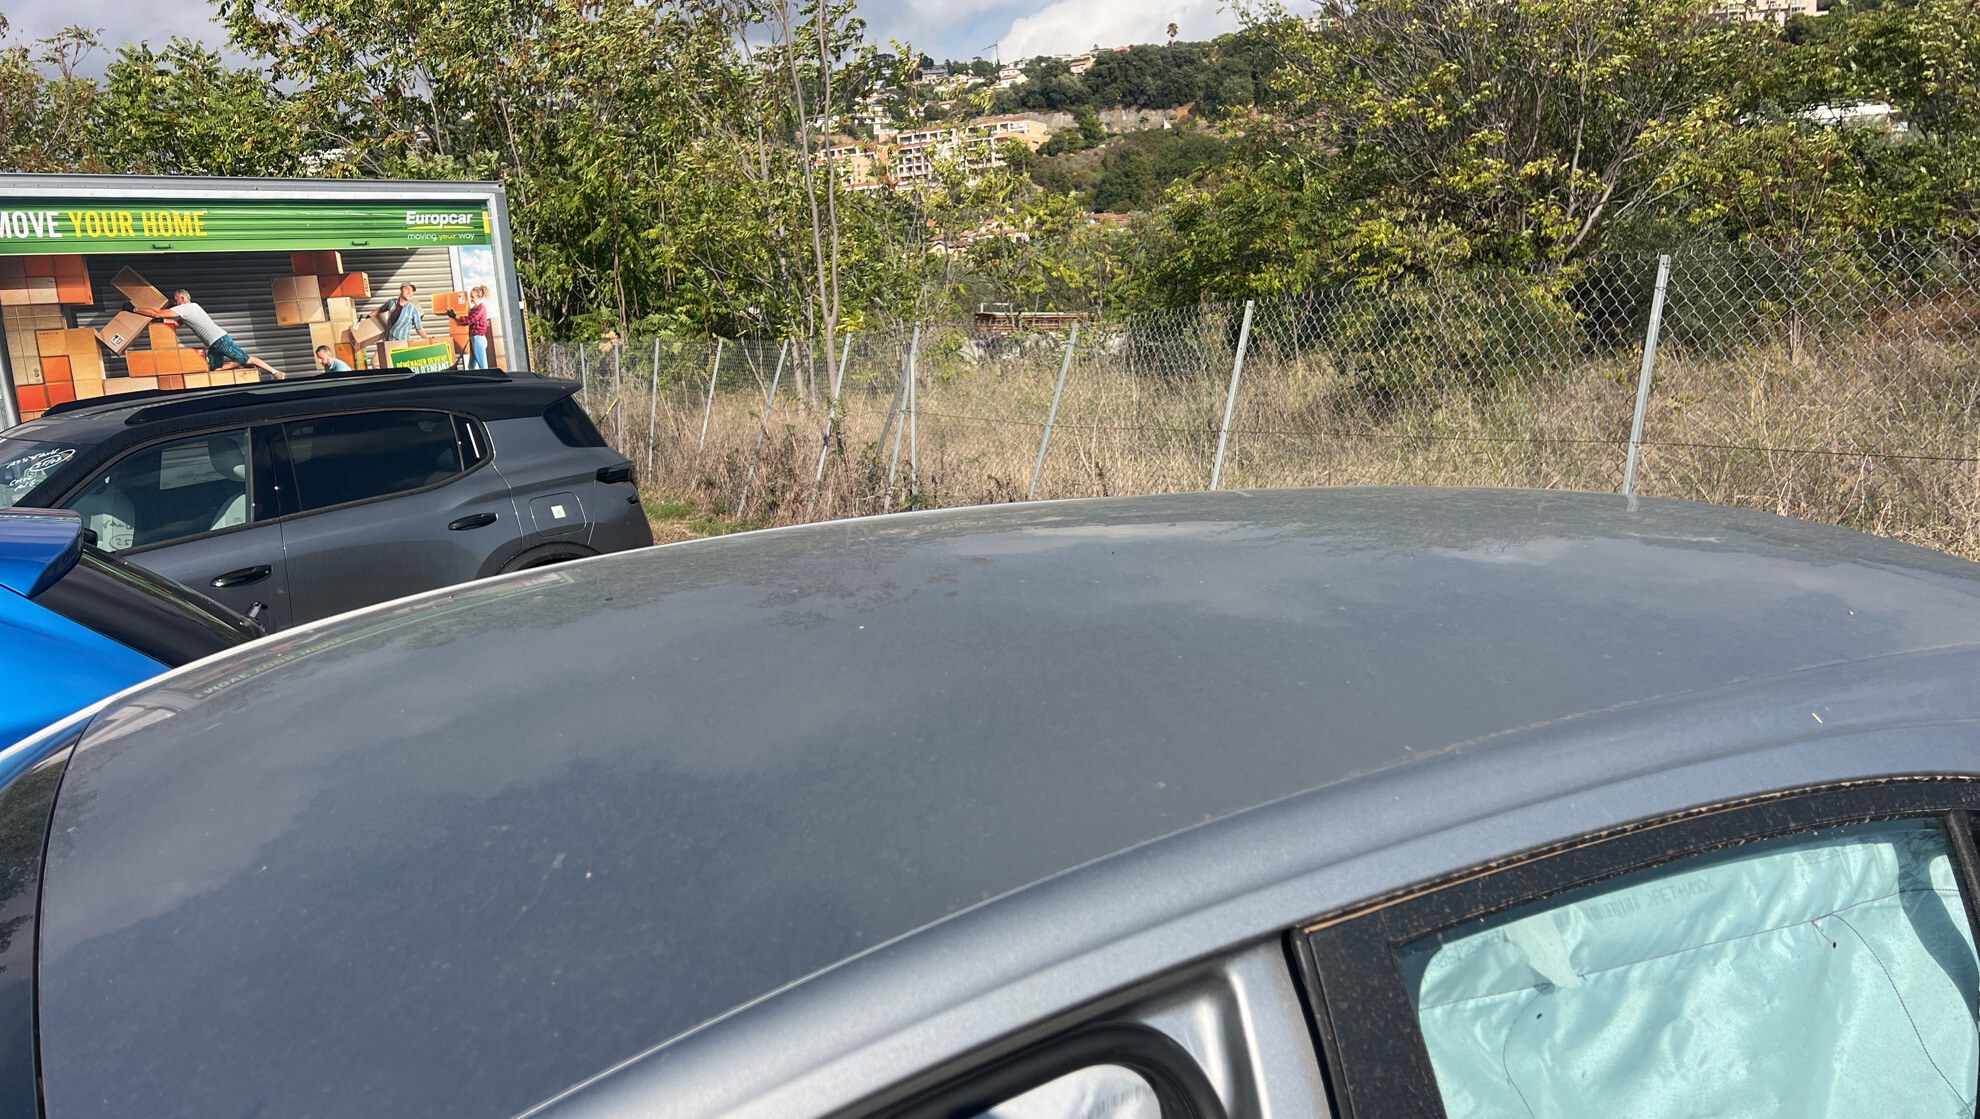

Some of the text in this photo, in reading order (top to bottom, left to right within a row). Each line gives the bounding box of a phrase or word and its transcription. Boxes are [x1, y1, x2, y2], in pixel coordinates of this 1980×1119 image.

[67, 210, 135, 237] YOUR
[141, 209, 208, 236] HOME
[406, 211, 473, 229] Europcar
[407, 233, 437, 241] moving
